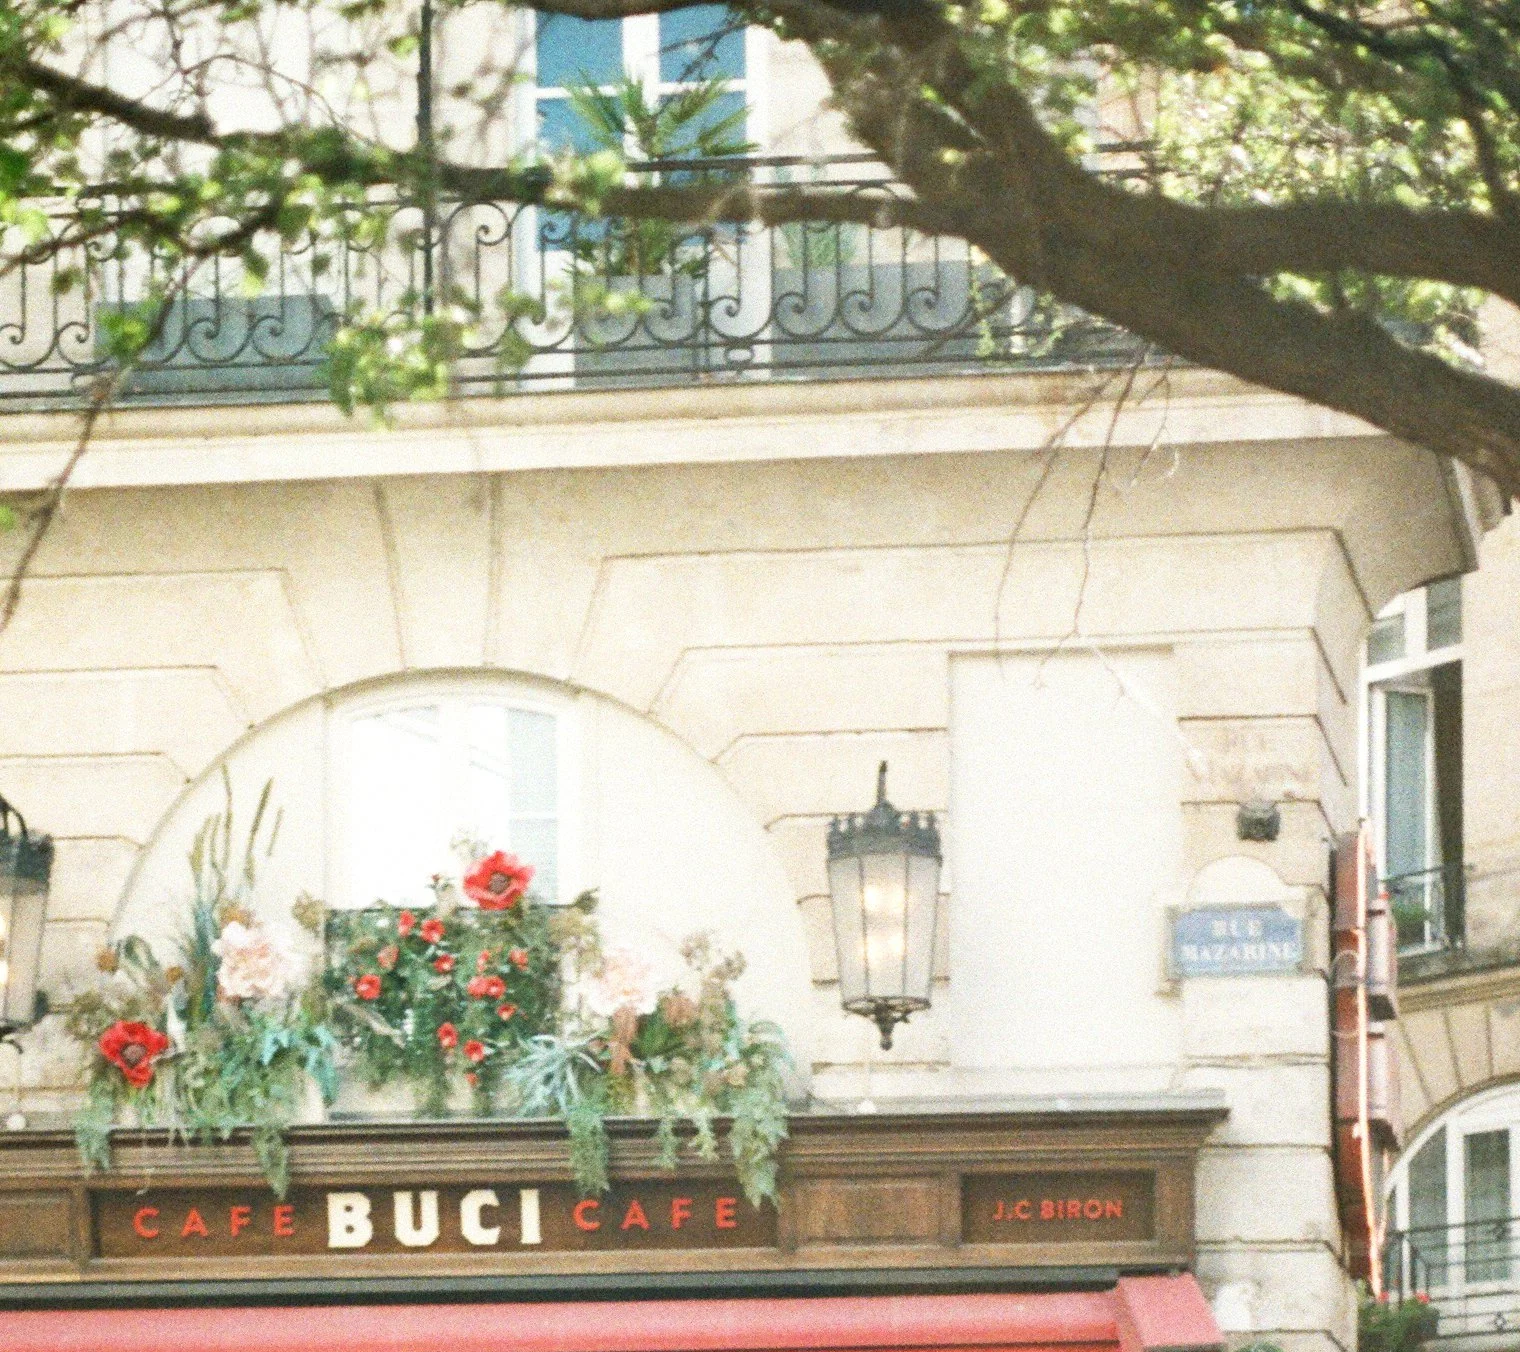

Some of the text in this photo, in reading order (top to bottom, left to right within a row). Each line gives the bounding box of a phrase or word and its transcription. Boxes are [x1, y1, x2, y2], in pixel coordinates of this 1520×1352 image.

[1211, 919, 1263, 938] RUE
[1180, 942, 1300, 961] MAZARINE
[132, 1188, 738, 1249] CAFE BUCI CAFE
[1040, 1199, 1123, 1220] BIRON
